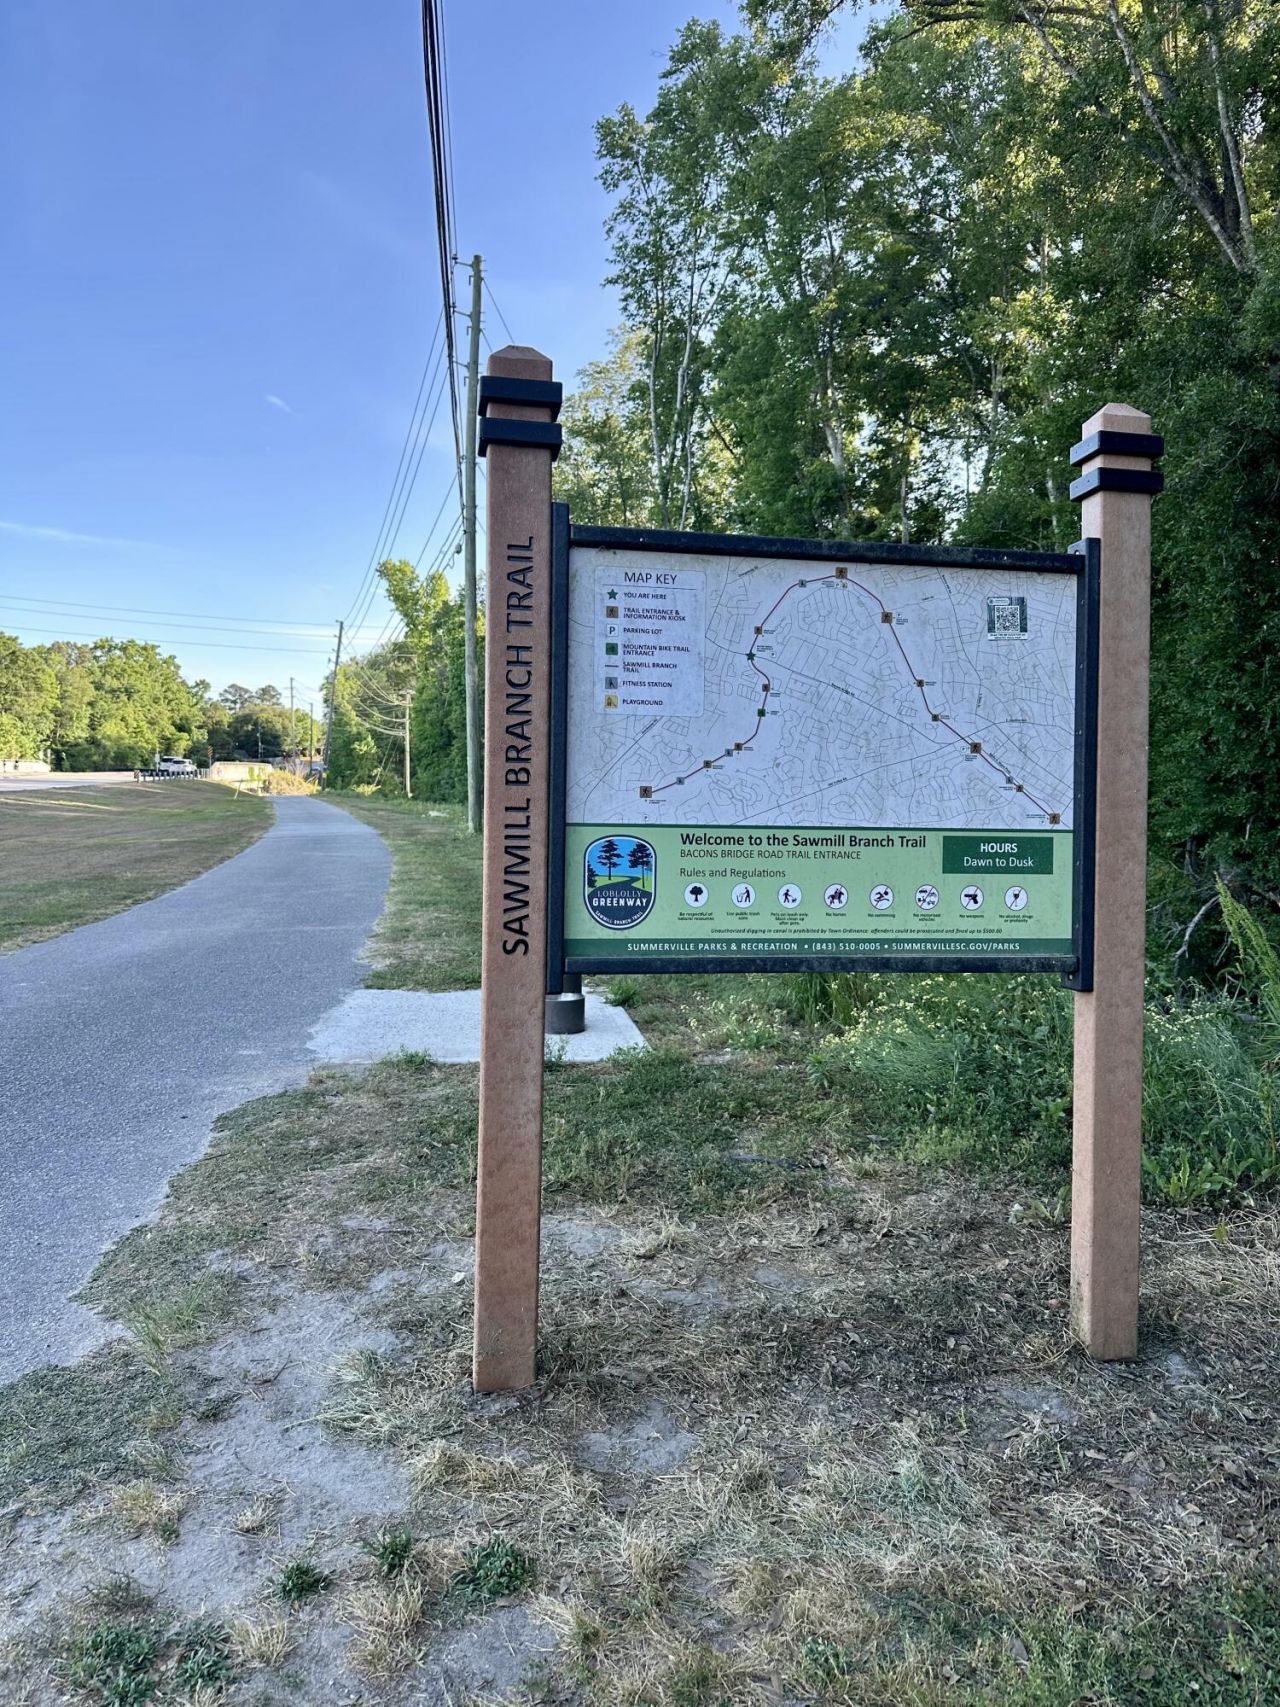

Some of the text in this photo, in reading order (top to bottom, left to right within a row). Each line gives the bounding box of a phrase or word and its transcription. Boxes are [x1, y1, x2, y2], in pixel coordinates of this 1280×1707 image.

[624, 571, 678, 584] MAP KEY
[638, 592, 650, 600] ARE
[624, 612, 667, 620] INFORMATION
[642, 608, 673, 616] ENTRANCE
[609, 626, 616, 635] P
[502, 535, 534, 956] SAWMILL BRANCH TRAIL
[680, 832, 926, 848] Welcome to the Sawmill Branch Trail
[980, 843, 1018, 853] HOURS
[680, 849, 861, 860] BACONS BRIDGE ROAD TRAIL ENTRANCE
[964, 856, 1034, 867] Dawn to Dusk
[680, 868, 786, 879] Rules and Regulations
[592, 898, 647, 906] GREENWAY
[595, 910, 612, 923] SAWMILL
[632, 911, 643, 920] TRAIL
[627, 943, 695, 951] SUMMERVILLE
[730, 942, 738, 950] &
[812, 942, 836, 952] (843)
[839, 942, 880, 950] 510-0005
[892, 942, 1020, 951] SUMMERVILLESC.GOV/PARKS
